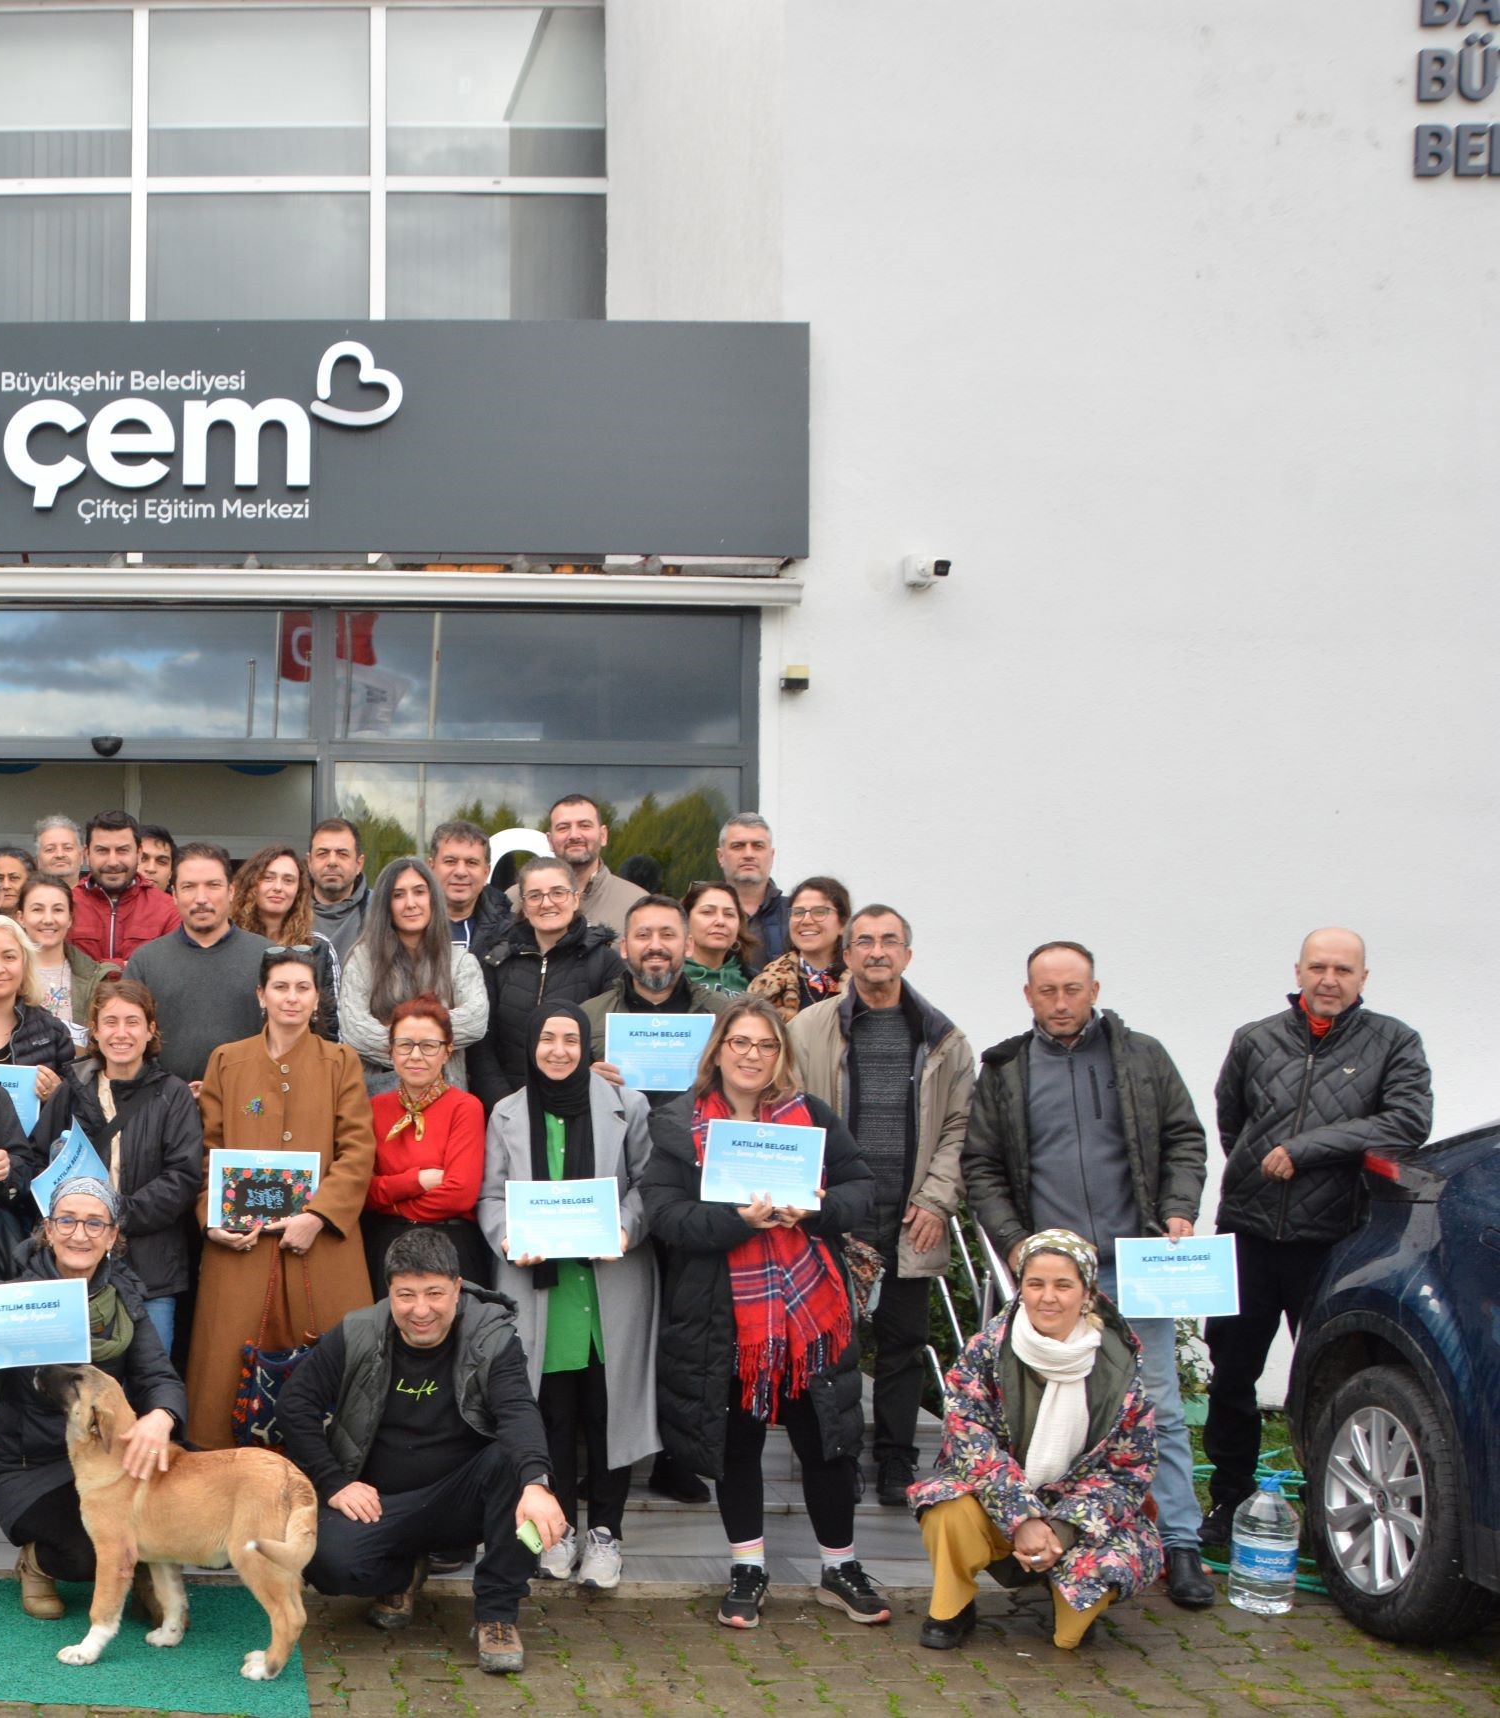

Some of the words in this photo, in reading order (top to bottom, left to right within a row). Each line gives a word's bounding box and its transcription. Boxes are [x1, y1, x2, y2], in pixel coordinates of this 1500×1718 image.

[1416, 32, 1500, 103] BÜ
[1, 371, 124, 395] Büyükşehir
[131, 370, 245, 393] Belediyesi
[77, 499, 137, 523] Çiftçi
[145, 497, 215, 522] Eğitim
[221, 497, 309, 519] Merkezi
[629, 1030, 659, 1038] KATILIM
[660, 1030, 691, 1038] BELGESİ
[732, 1140, 763, 1149] KATILIM
[764, 1143, 798, 1152] BELGESİ
[25, 1299, 60, 1310] BELGESİ
